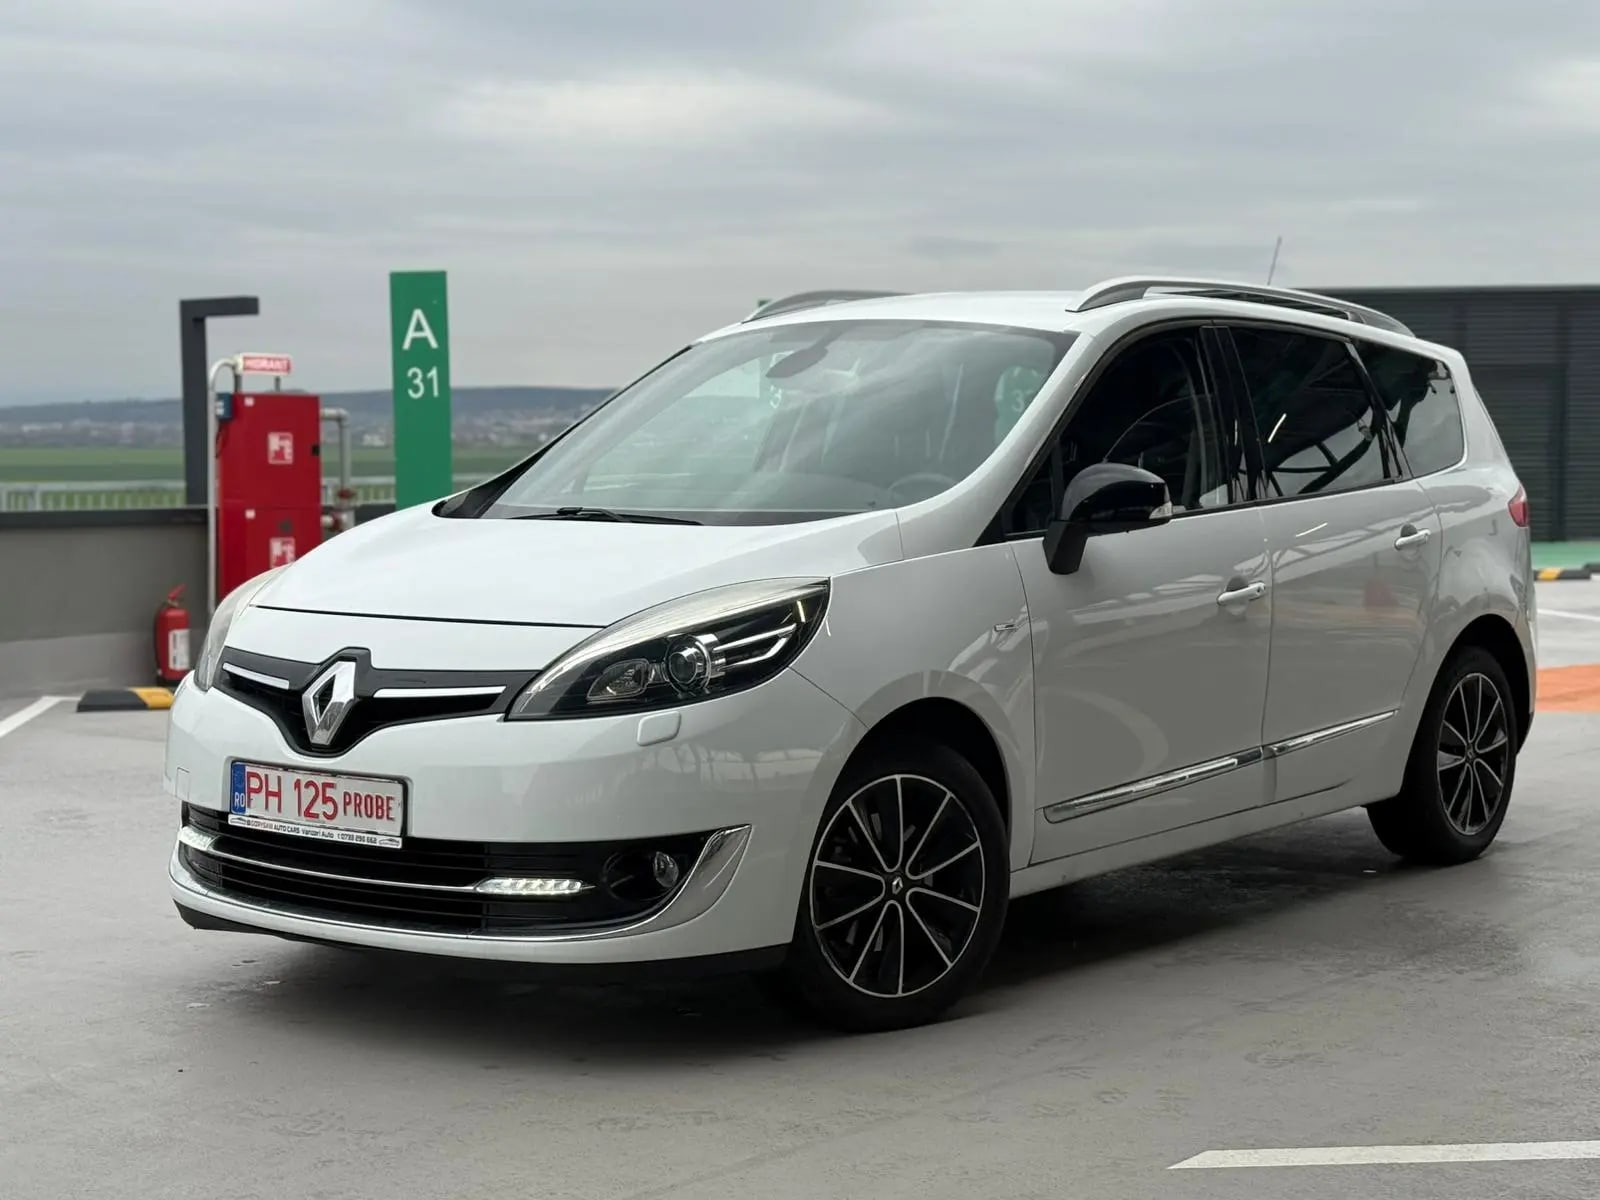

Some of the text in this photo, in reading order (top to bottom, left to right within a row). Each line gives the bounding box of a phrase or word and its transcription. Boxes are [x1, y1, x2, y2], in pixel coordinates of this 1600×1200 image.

[402, 308, 439, 350] A
[407, 366, 439, 399] 31
[234, 791, 245, 808] RO
[247, 771, 396, 822] PH 125 PROBE
[273, 823, 286, 832] AUTO
